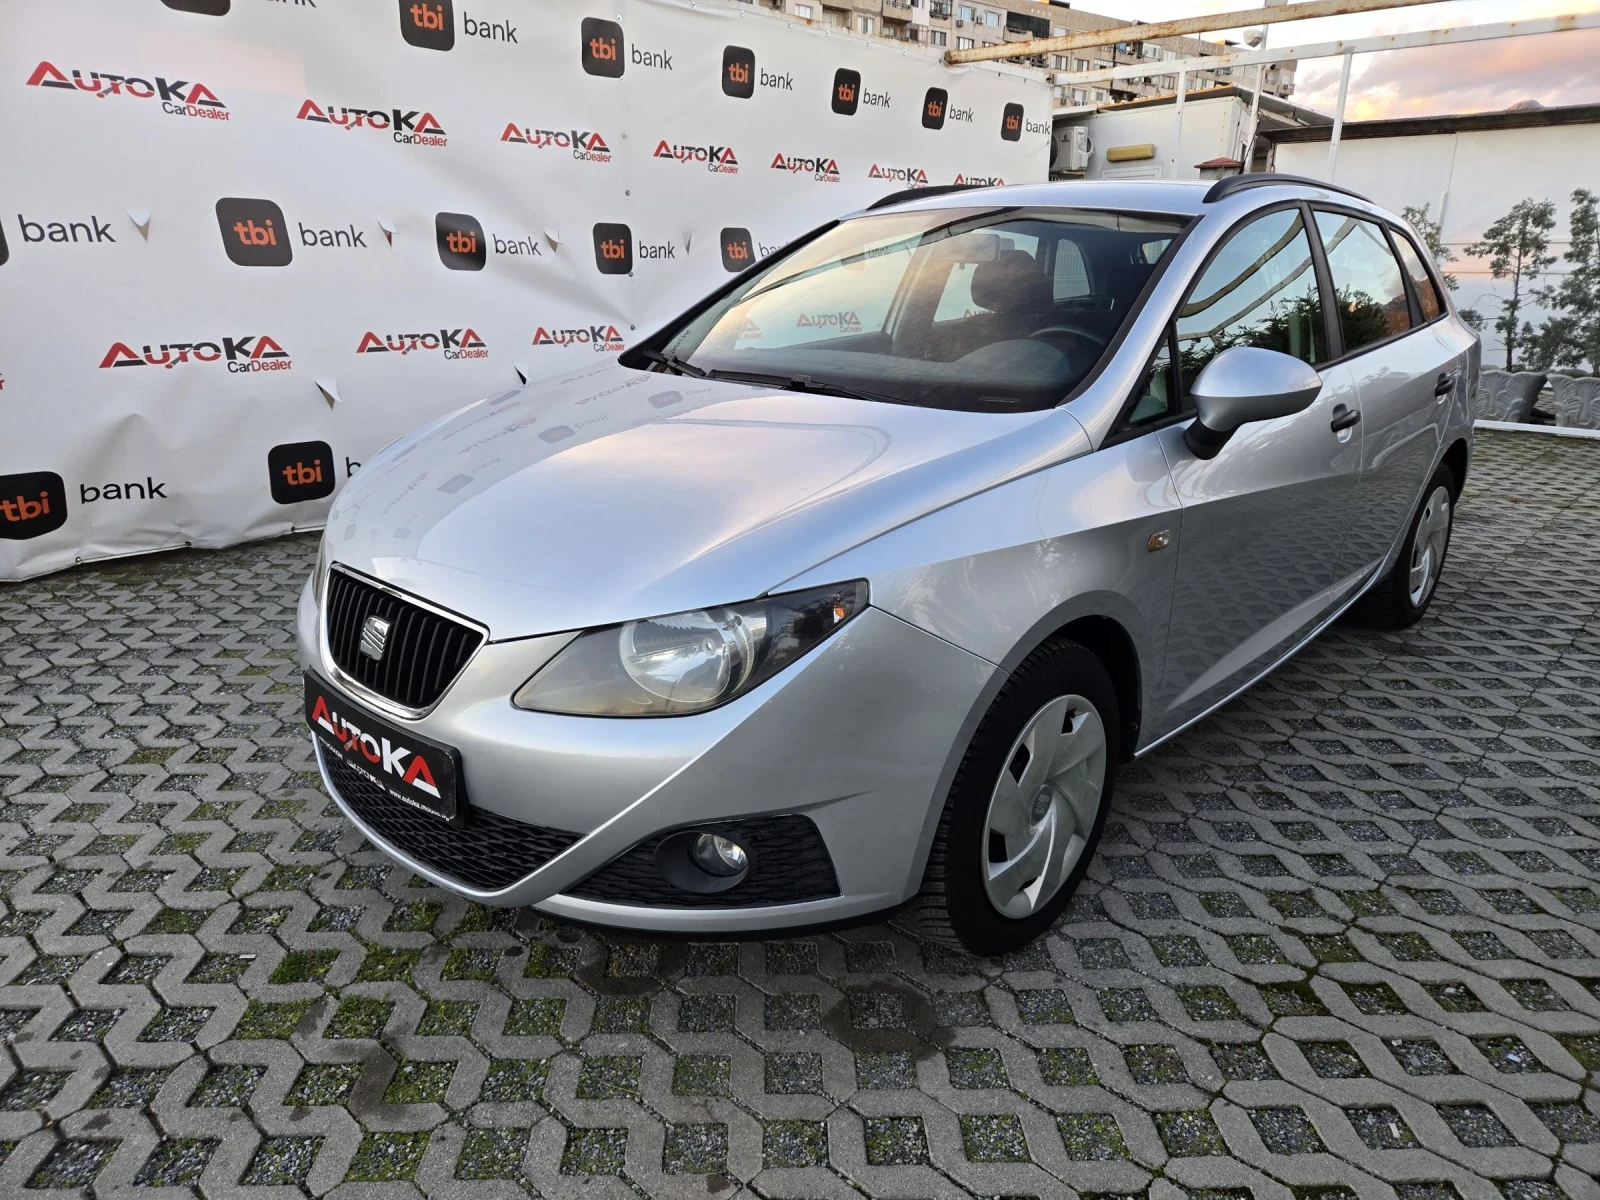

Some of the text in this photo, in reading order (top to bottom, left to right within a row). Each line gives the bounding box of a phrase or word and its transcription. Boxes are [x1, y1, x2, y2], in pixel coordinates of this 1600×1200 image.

[410, 4, 518, 44] tbi bank
[589, 37, 673, 70] tbi bank
[728, 62, 793, 91] tbi bank
[838, 84, 891, 109] tbi bank
[162, 102, 230, 121] CarDealer
[928, 101, 974, 122] tbi bank
[1006, 115, 1050, 135] tbi bank
[393, 131, 448, 147] CarDealer
[573, 150, 612, 163] CarDealer
[708, 163, 739, 174] CarDealer
[814, 173, 841, 182] CarDealer
[18, 214, 116, 243] bank
[234, 220, 367, 248] tbi bank
[446, 231, 542, 256] tbi bank
[600, 239, 675, 260] tbi bank
[727, 241, 748, 259] tbi
[444, 348, 488, 359] CarDealer
[593, 342, 625, 352] CarDealer
[227, 359, 292, 374] CarDealer
[283, 459, 323, 486] tbi
[0, 477, 168, 521] tbi bank
[312, 696, 441, 799] AUTOKA
